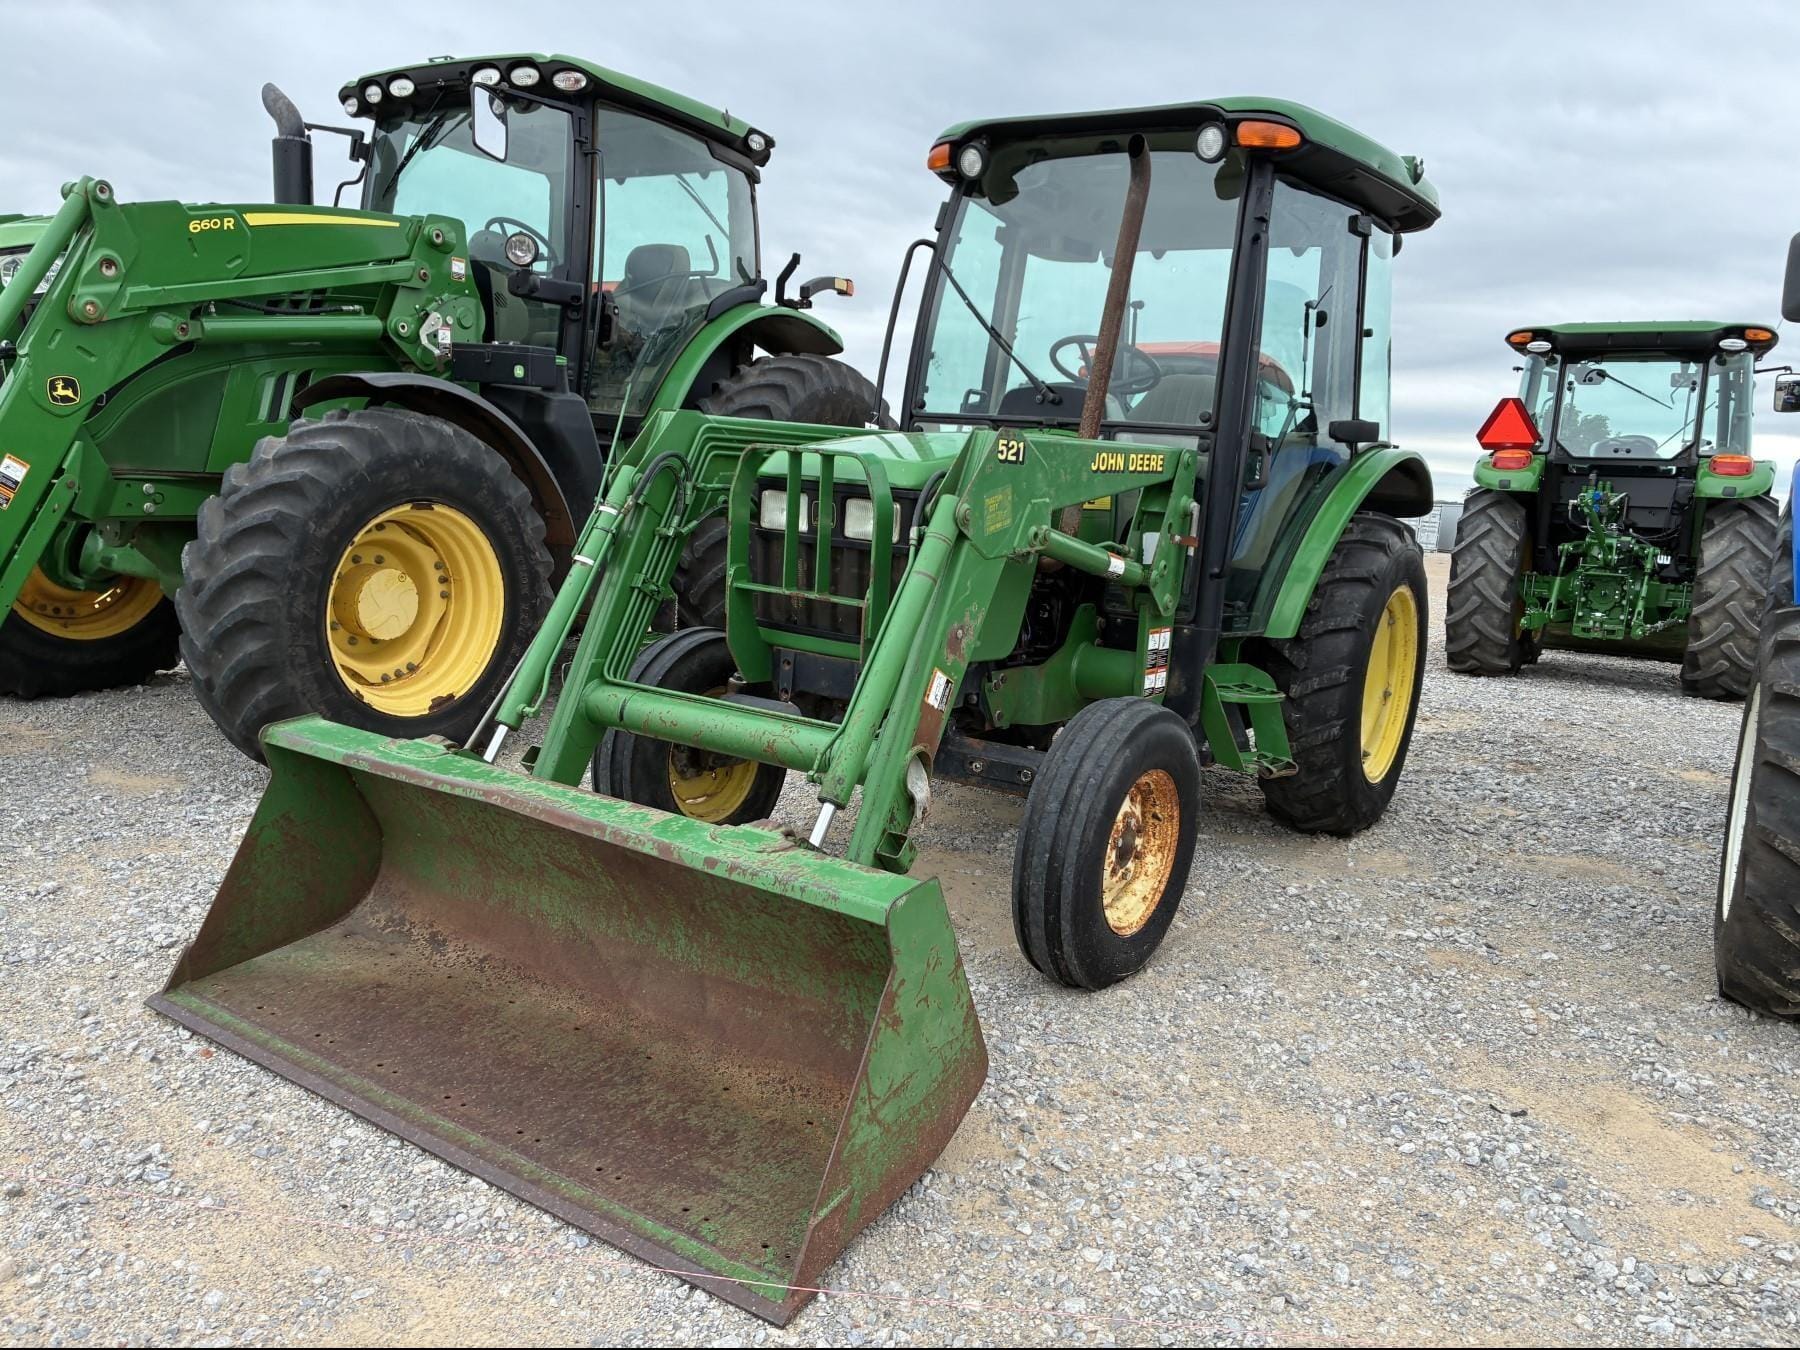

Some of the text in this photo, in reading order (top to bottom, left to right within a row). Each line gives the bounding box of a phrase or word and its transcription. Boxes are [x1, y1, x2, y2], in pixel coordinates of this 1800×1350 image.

[997, 439, 1025, 463] 521
[1091, 452, 1165, 473] JOHN DEERE
